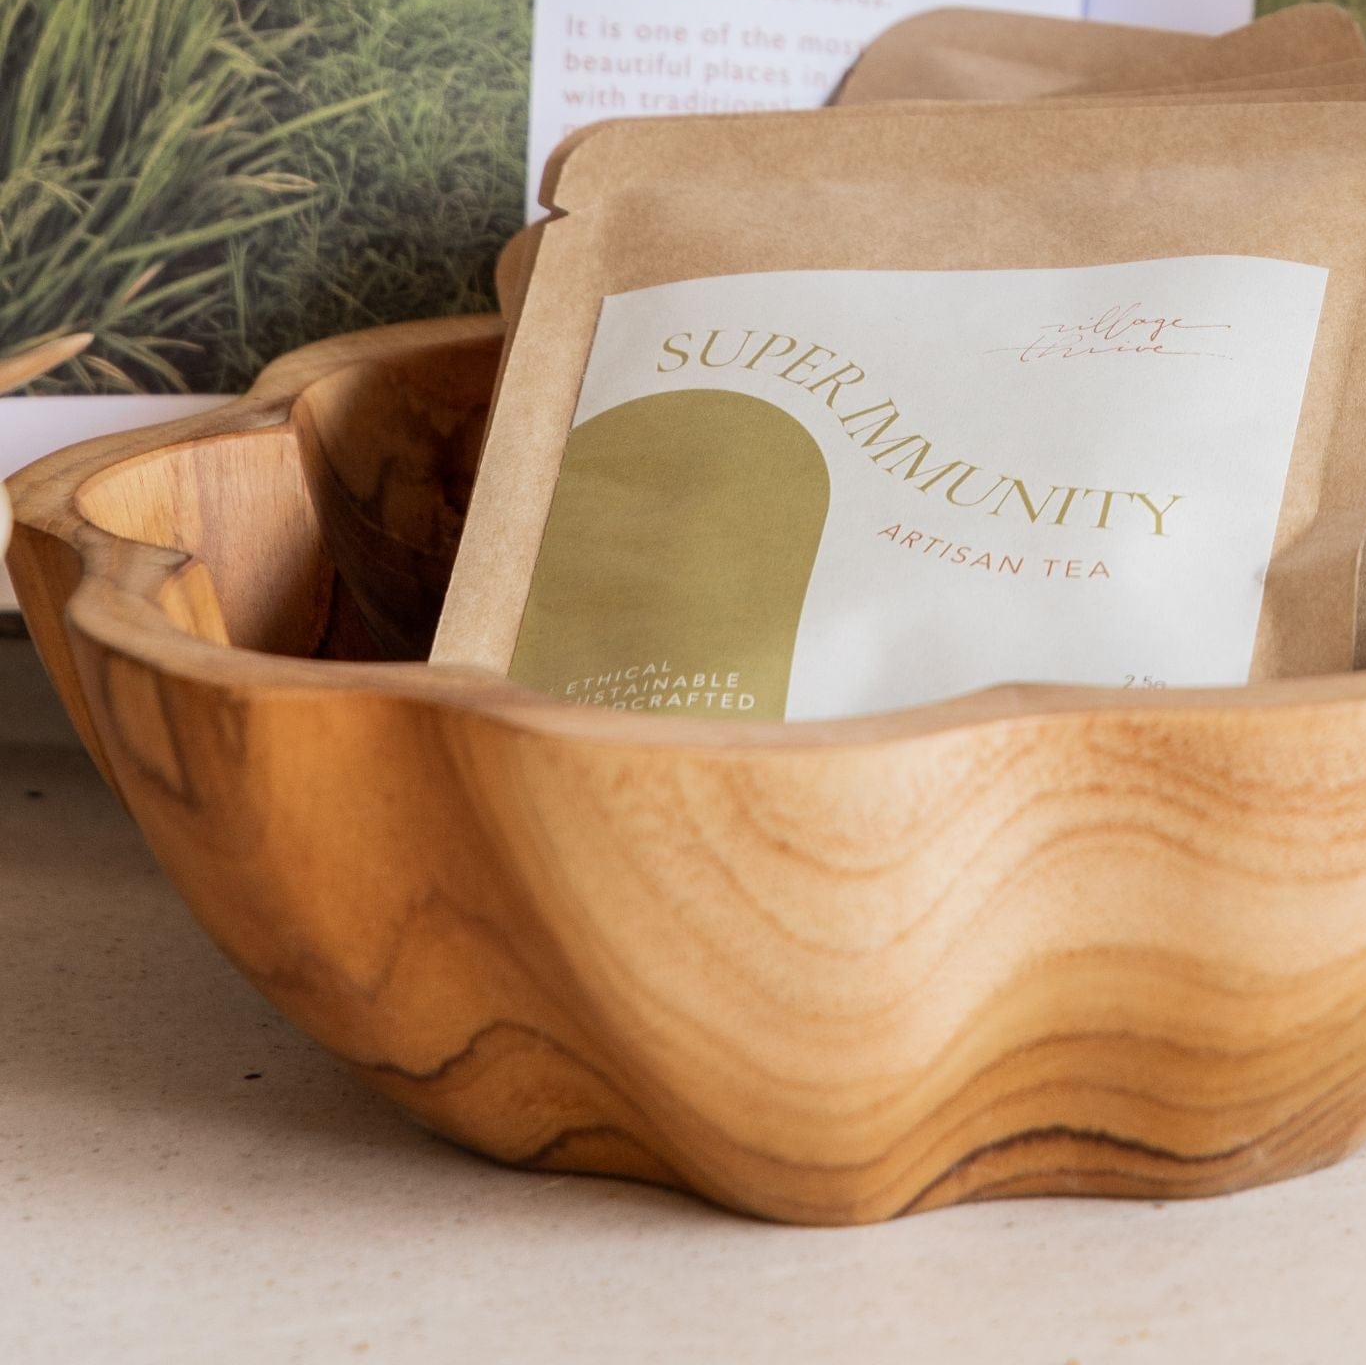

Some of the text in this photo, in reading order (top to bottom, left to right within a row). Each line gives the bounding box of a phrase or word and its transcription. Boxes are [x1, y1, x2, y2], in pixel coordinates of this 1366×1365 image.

[566, 14, 587, 39] It
[600, 16, 622, 39] is
[634, 23, 688, 45] one
[701, 22, 731, 46] of
[742, 27, 786, 52] the
[564, 49, 692, 78] beautiful
[704, 59, 791, 86] places
[563, 87, 625, 108] with
[1040, 302, 1231, 341] village
[977, 334, 1233, 363] thrive
[877, 522, 1111, 579] ARTISAN TEA
[565, 660, 672, 696] ETHICAL
[566, 672, 740, 707] USTAINABLE
